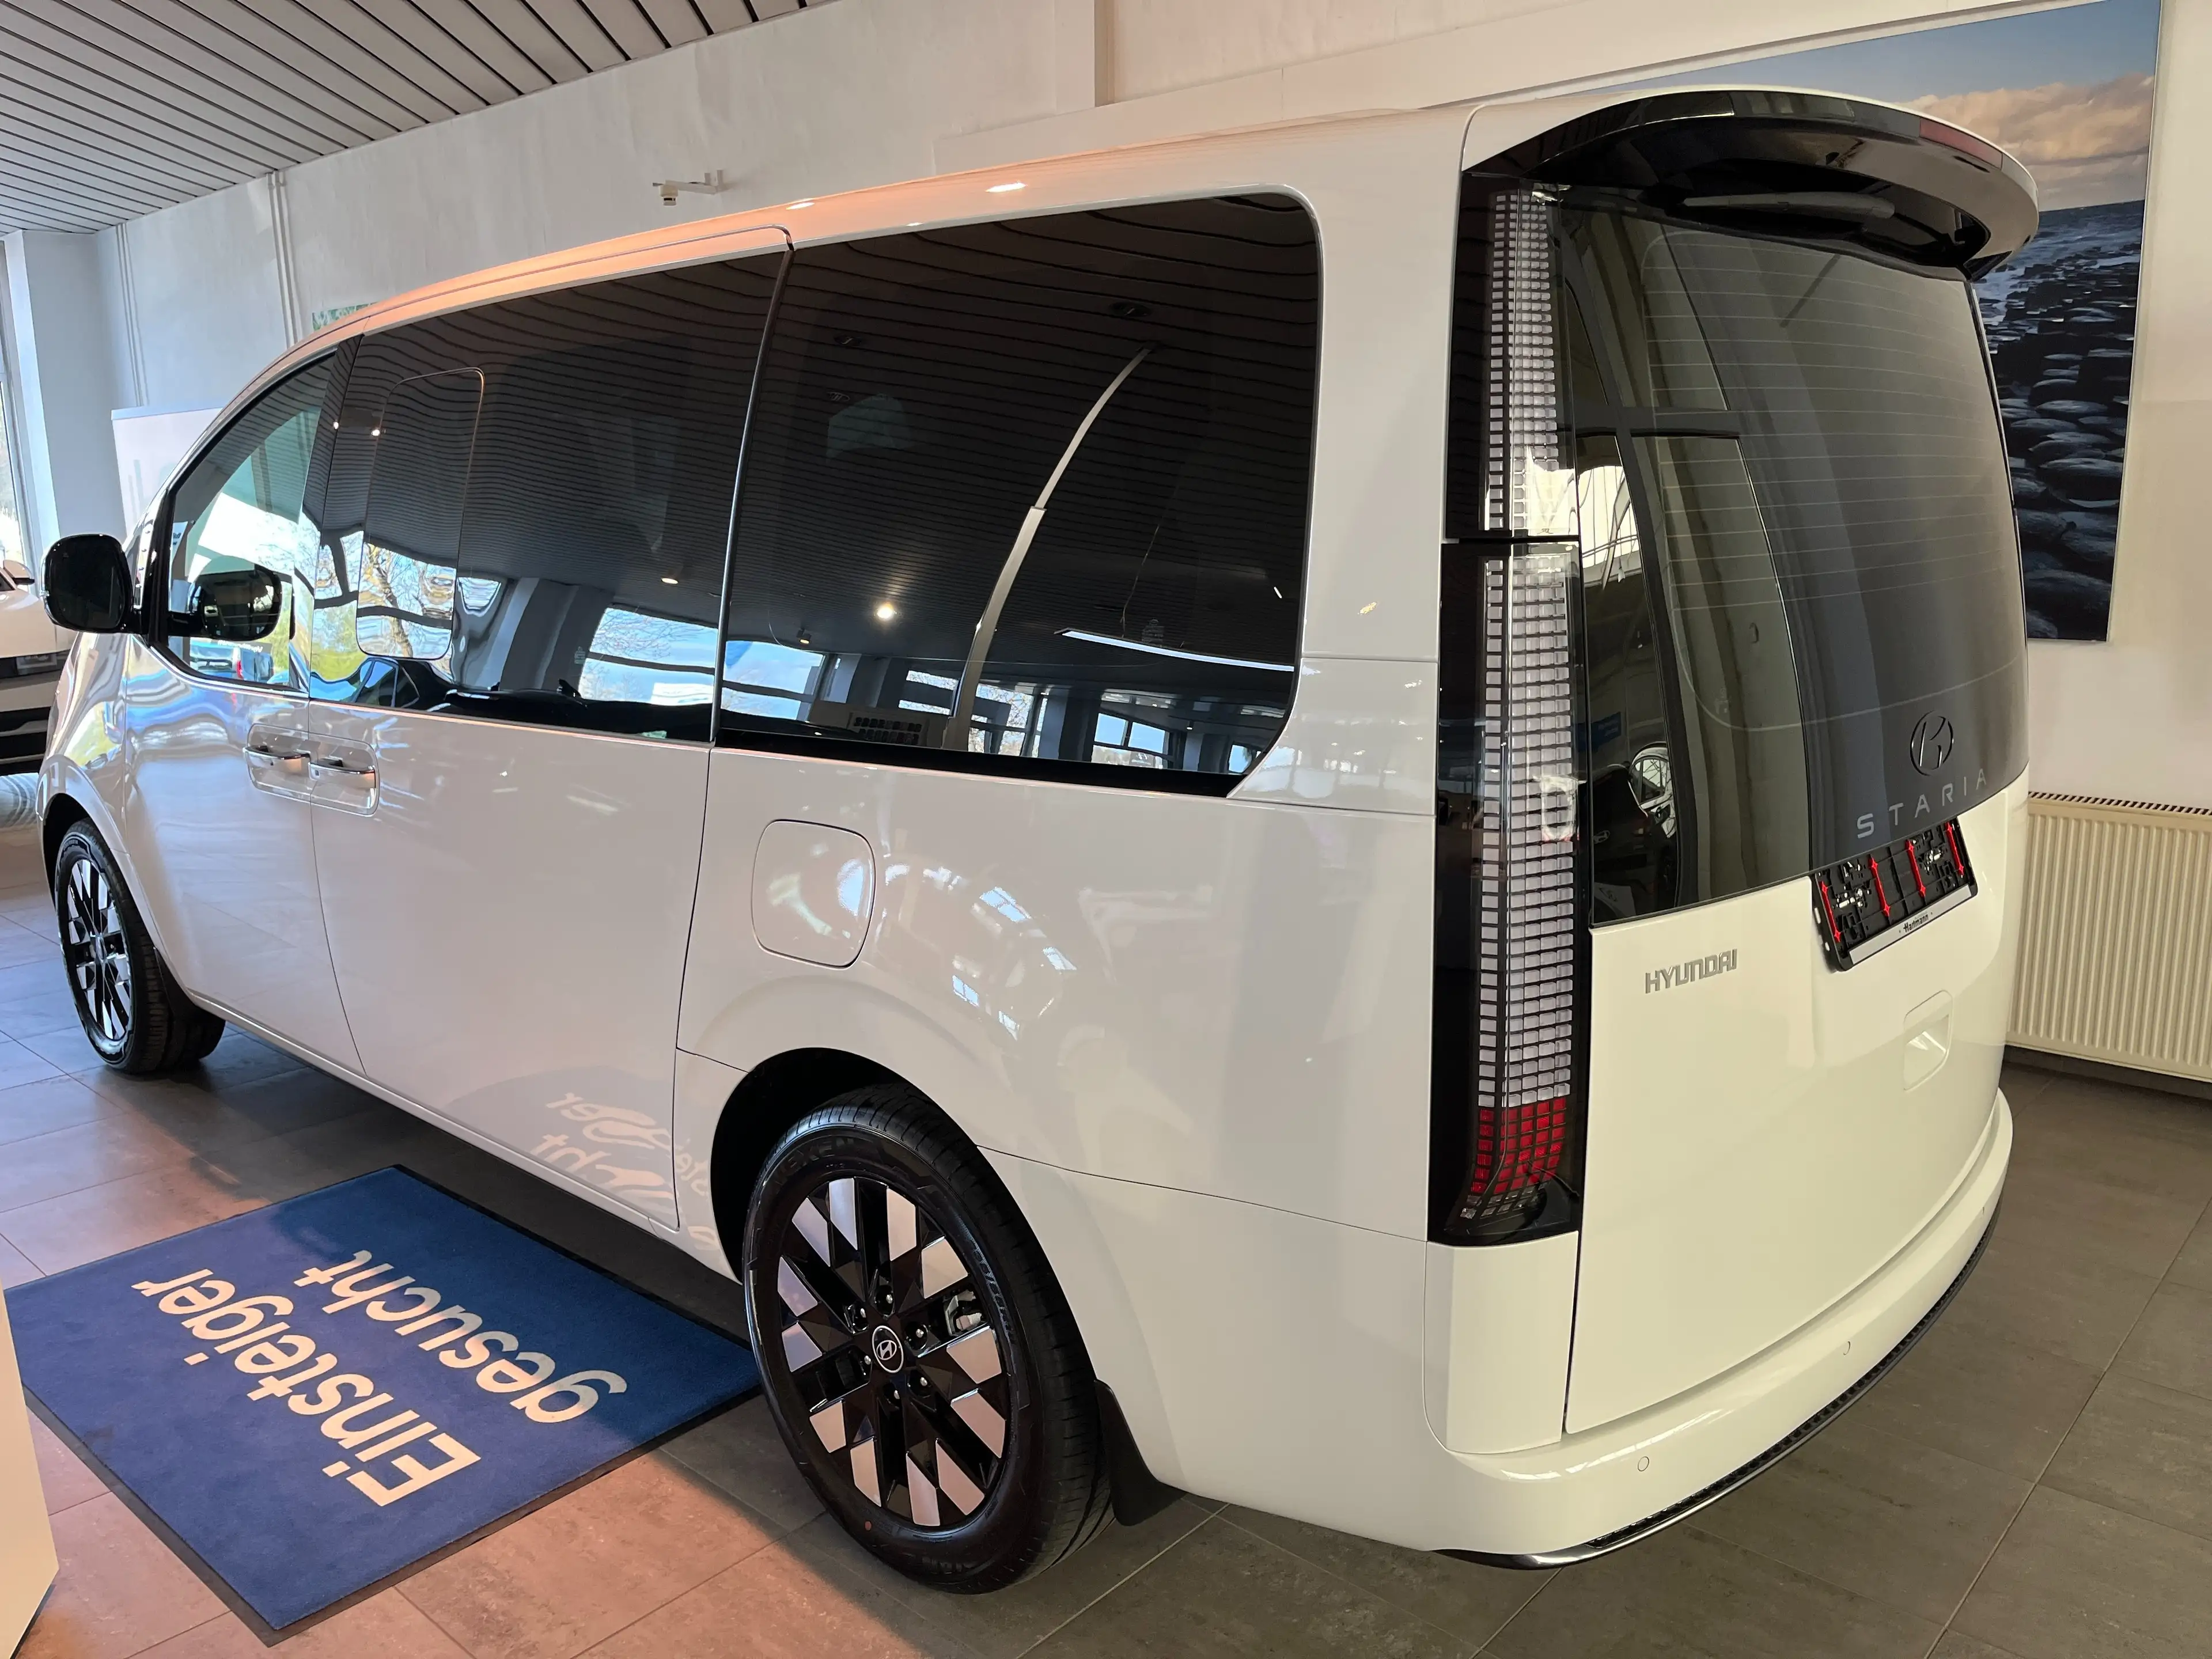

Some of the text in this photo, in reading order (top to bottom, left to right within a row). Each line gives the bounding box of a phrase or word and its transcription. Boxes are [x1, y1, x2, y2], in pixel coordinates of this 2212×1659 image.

[1857, 768, 1987, 839] STARIA
[1903, 914, 1929, 933] Hartmann
[1645, 949, 1737, 994] HYUNDAI
[294, 1249, 627, 1424] gesucht
[132, 1268, 481, 1507] Einsteiger
